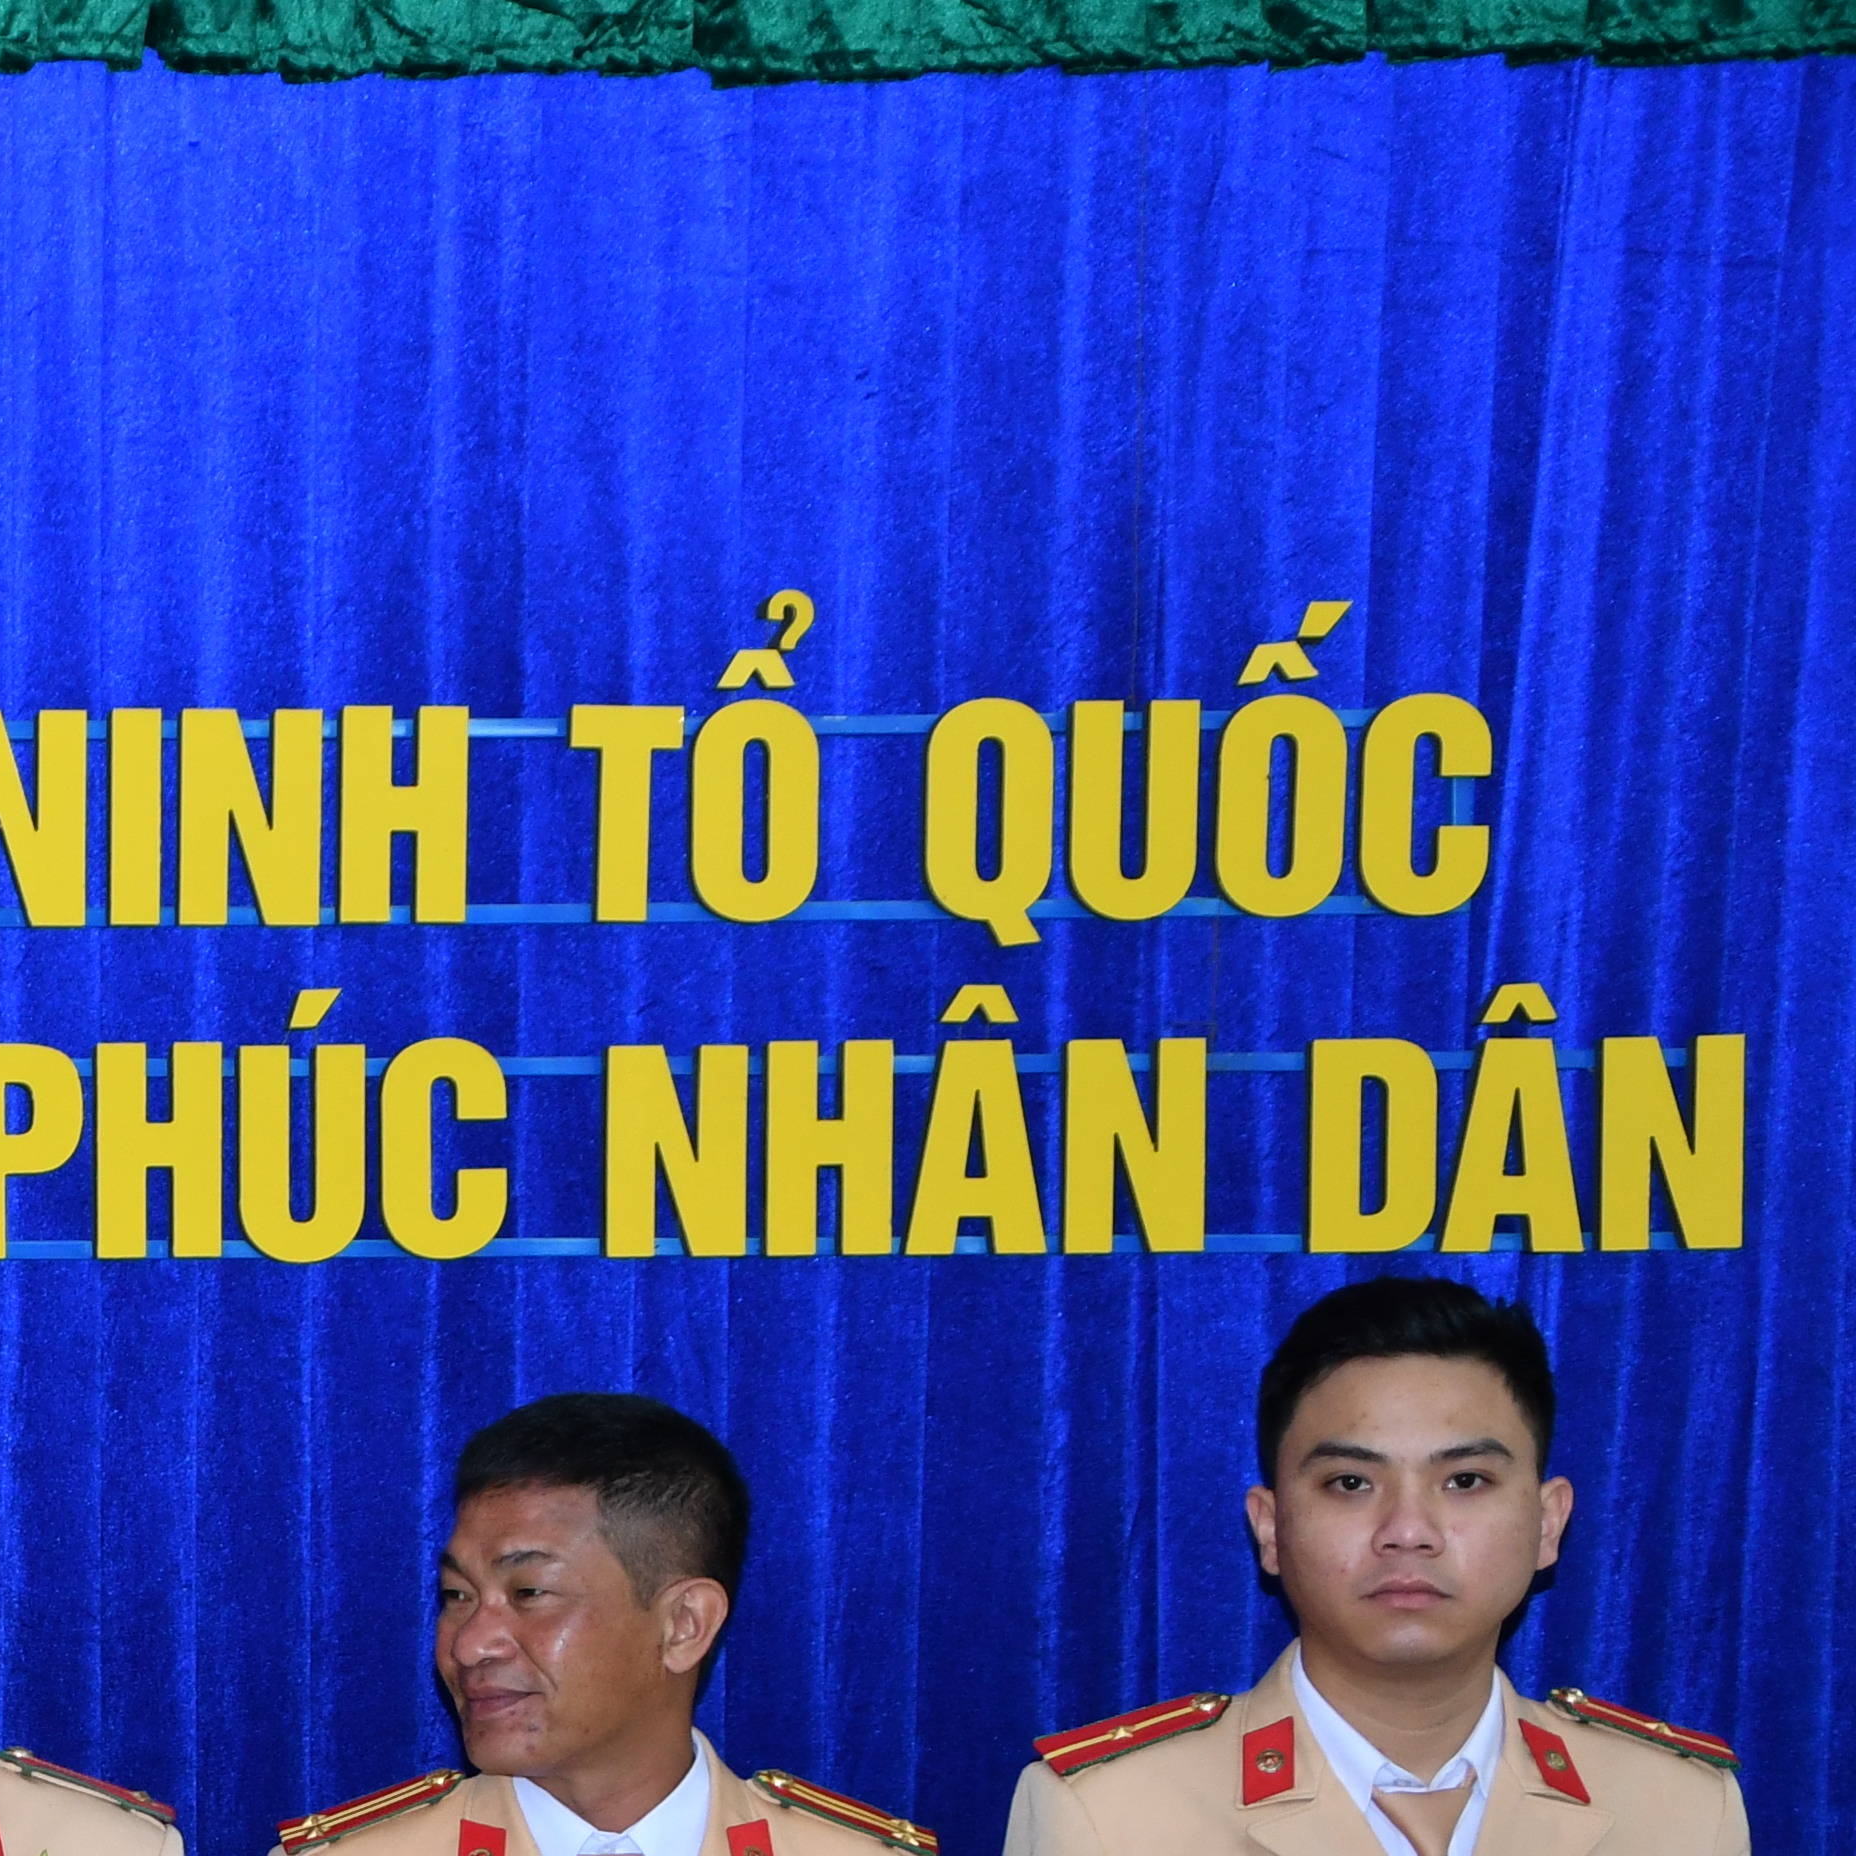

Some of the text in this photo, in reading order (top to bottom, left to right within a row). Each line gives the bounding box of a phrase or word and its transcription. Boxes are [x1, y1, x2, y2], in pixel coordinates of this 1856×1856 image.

[570, 590, 820, 923] TỔ
[926, 601, 1492, 946] QUỐC
[606, 984, 1207, 1259] NHÂN
[1309, 983, 1746, 1254] DÂN
